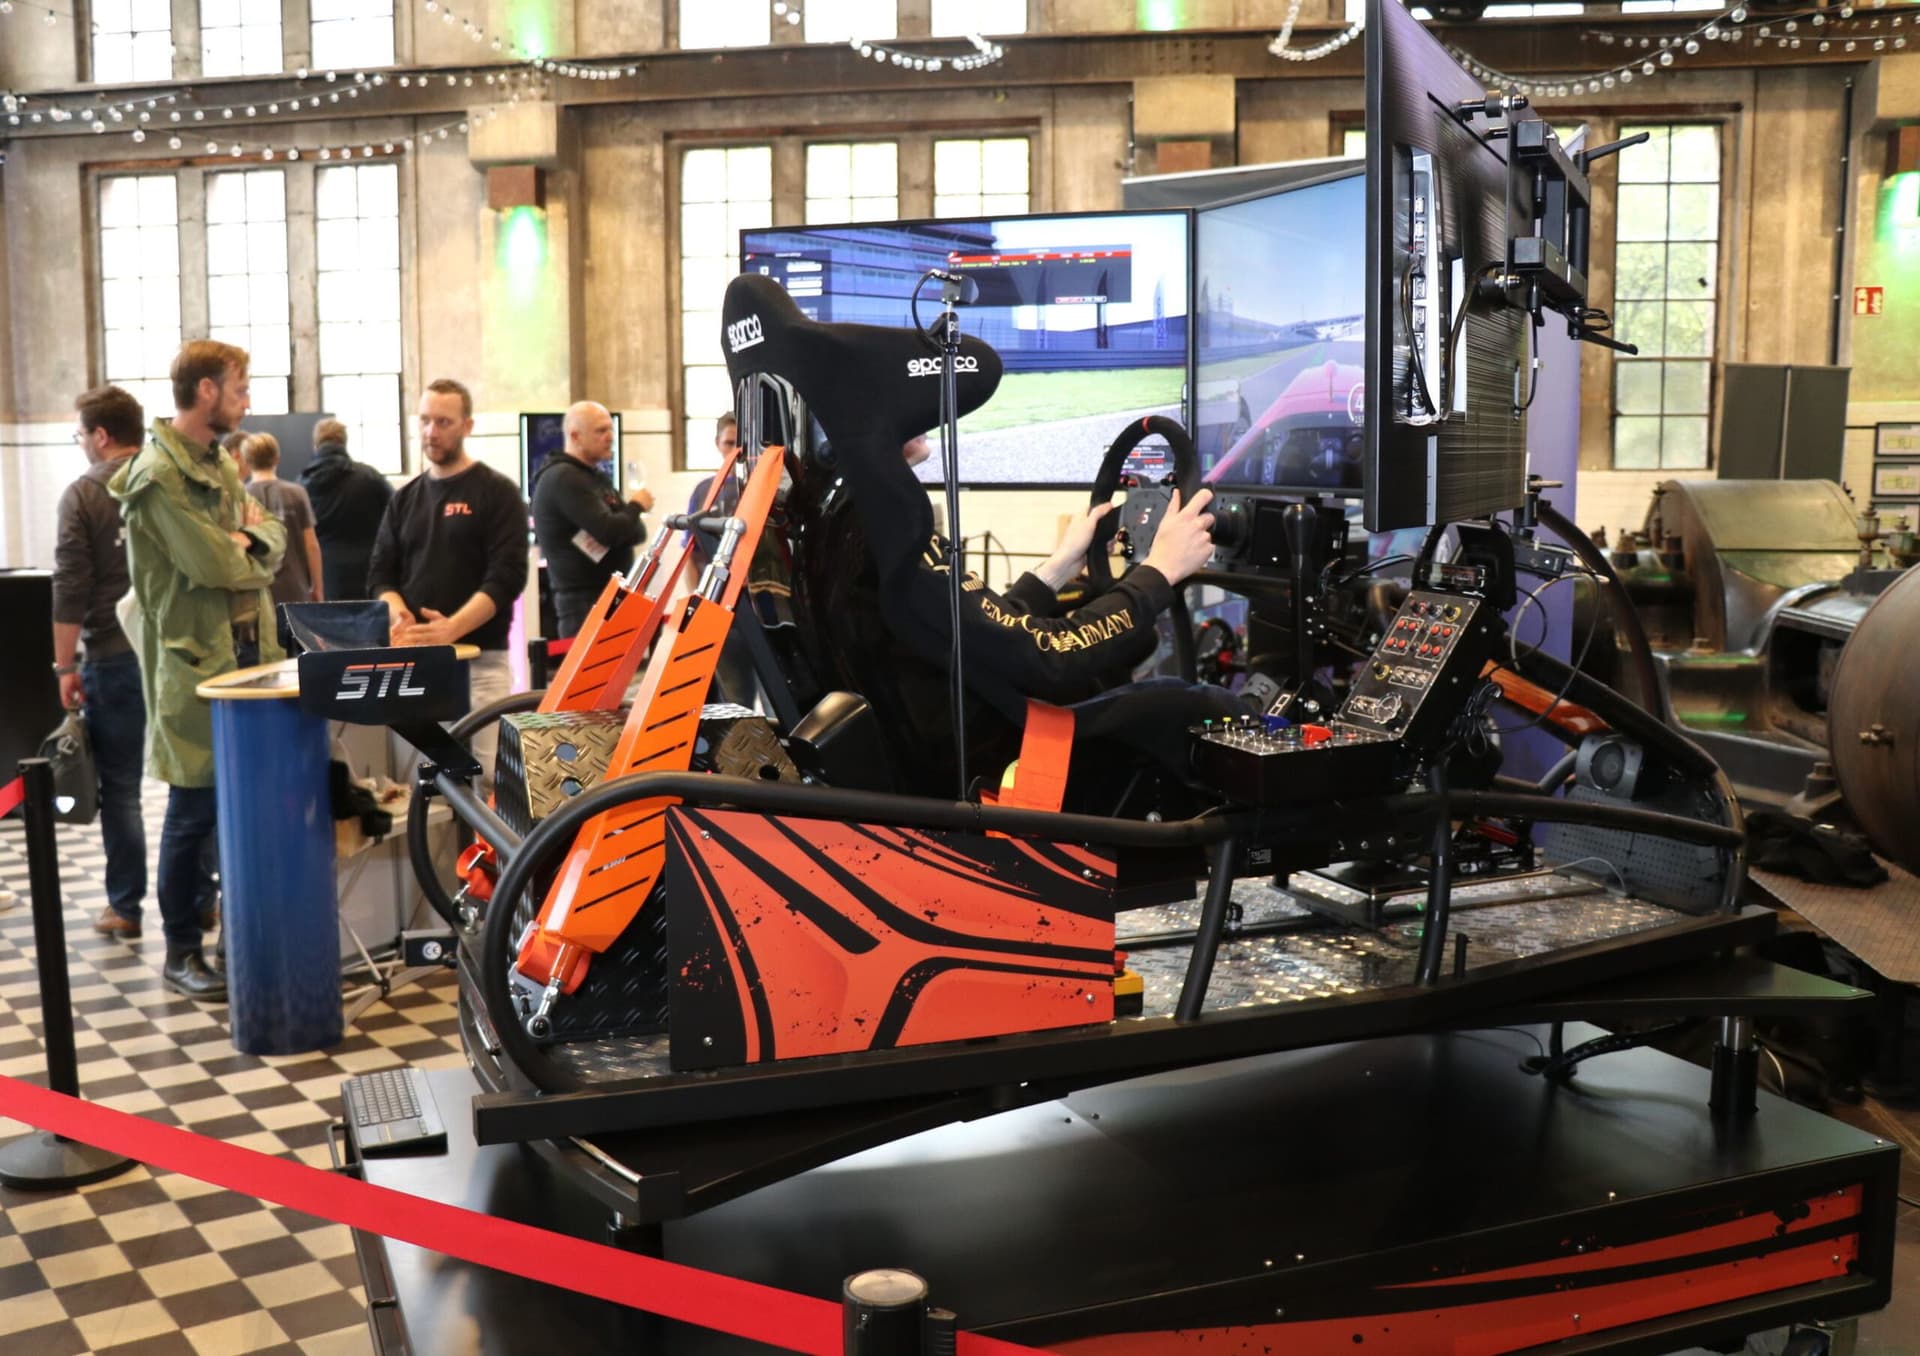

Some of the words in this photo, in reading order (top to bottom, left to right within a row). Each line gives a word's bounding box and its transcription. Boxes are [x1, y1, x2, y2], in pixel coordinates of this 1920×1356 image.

[728, 313, 763, 352] sparco
[907, 356, 978, 376] spaco
[444, 502, 472, 516] STL
[1066, 608, 1134, 649] ARMANI
[336, 662, 425, 700] STL
